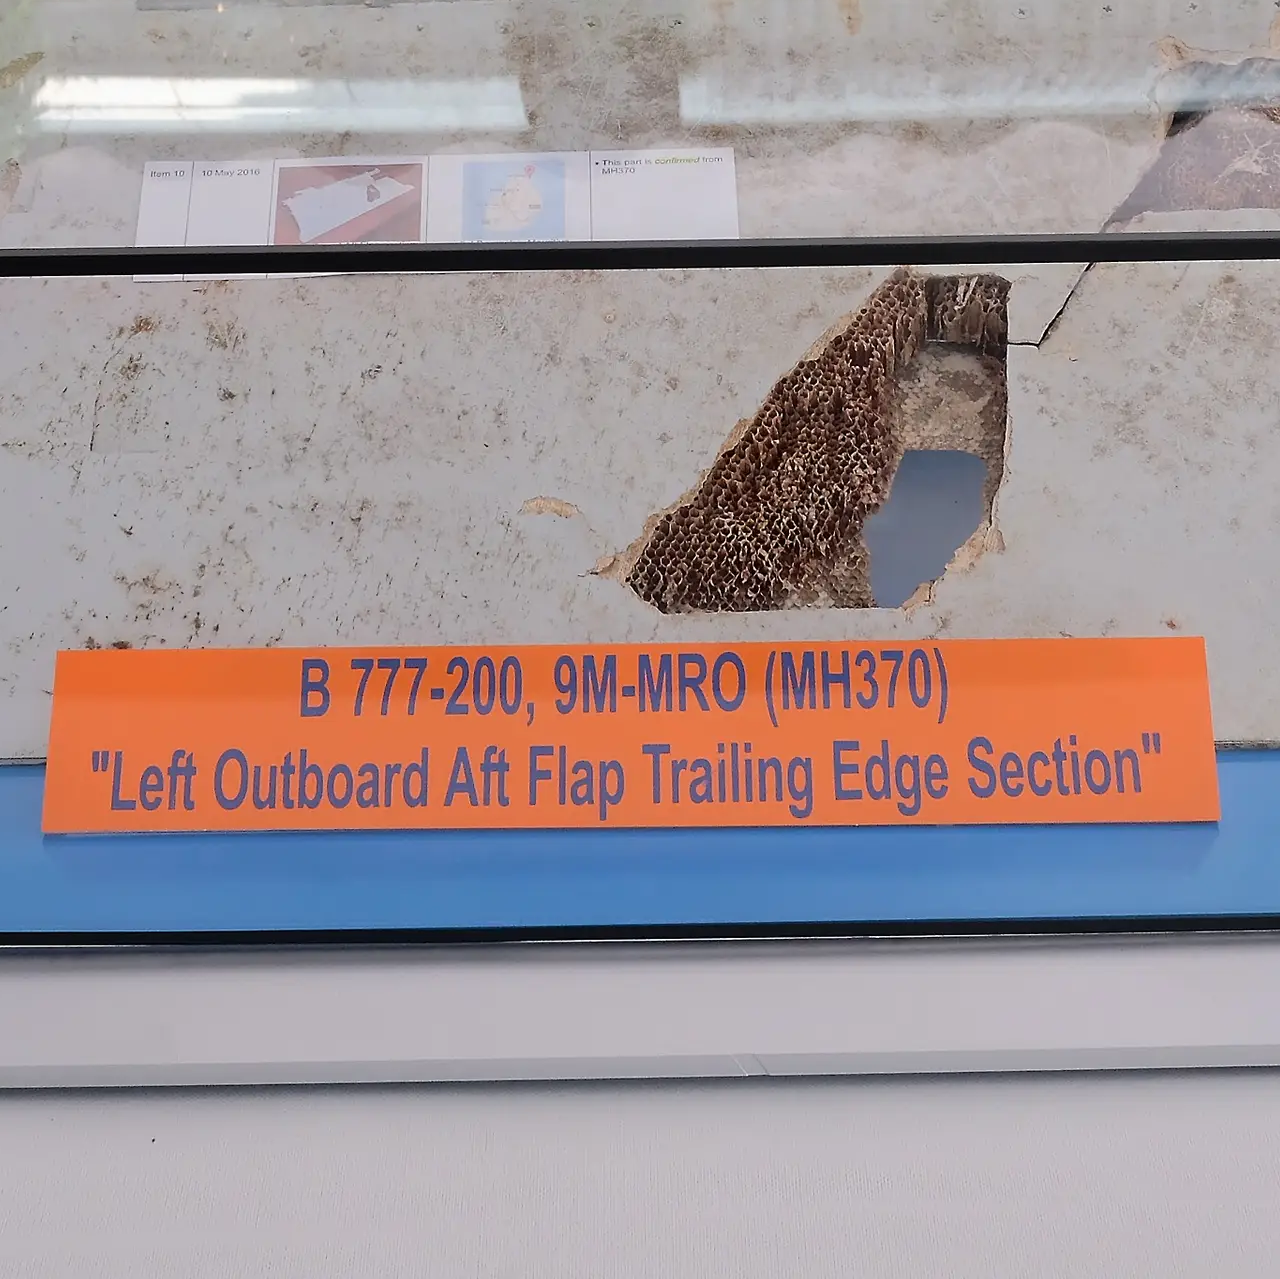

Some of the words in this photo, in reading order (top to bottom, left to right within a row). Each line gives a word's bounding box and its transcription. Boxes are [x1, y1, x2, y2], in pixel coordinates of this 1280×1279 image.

[624, 158, 642, 167] part
[654, 156, 701, 165] confirmed
[150, 170, 171, 178] Item
[214, 169, 235, 178] May
[236, 168, 261, 176] 2016
[301, 659, 330, 716] B
[351, 656, 535, 726] 777-200,
[555, 652, 745, 713] 9M-MRO
[766, 649, 947, 724] (MH370)
[93, 750, 196, 810] "Left
[215, 748, 428, 809] Outboard
[445, 746, 509, 805] Aft
[530, 746, 624, 820] Flap
[643, 743, 813, 818] Trailing
[834, 741, 948, 815] Edge
[968, 733, 1160, 797] Section"
